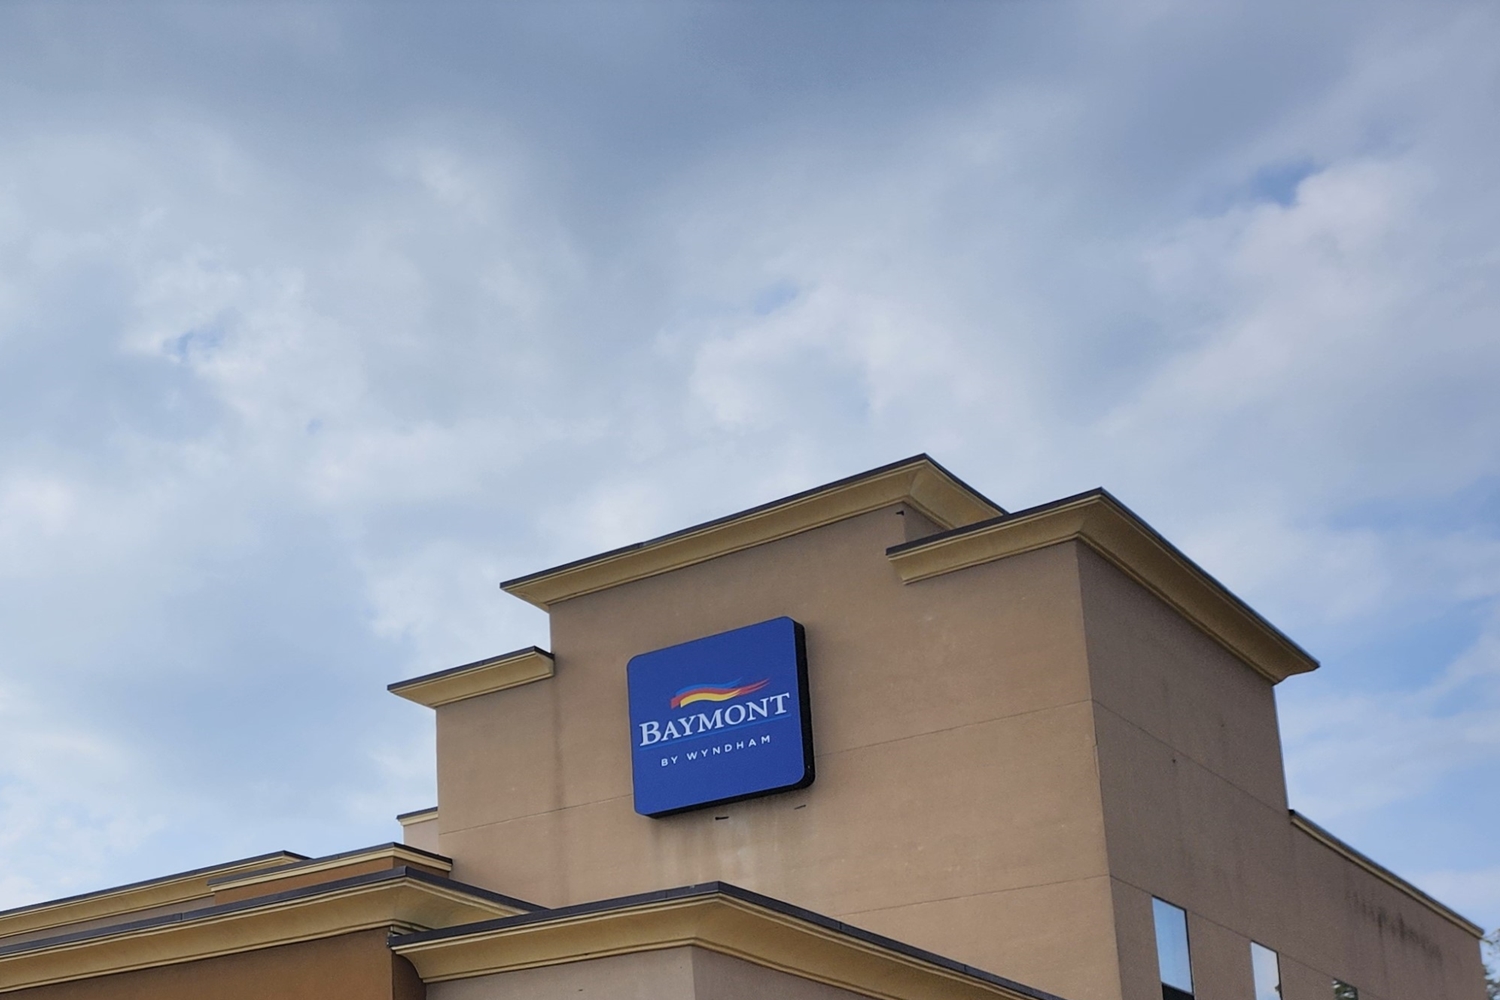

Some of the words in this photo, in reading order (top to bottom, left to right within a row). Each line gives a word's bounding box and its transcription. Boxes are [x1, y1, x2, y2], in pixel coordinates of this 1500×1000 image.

[639, 692, 790, 747] BAYMONT
[661, 756, 678, 767] BY
[686, 735, 771, 761] WYNDHAM
